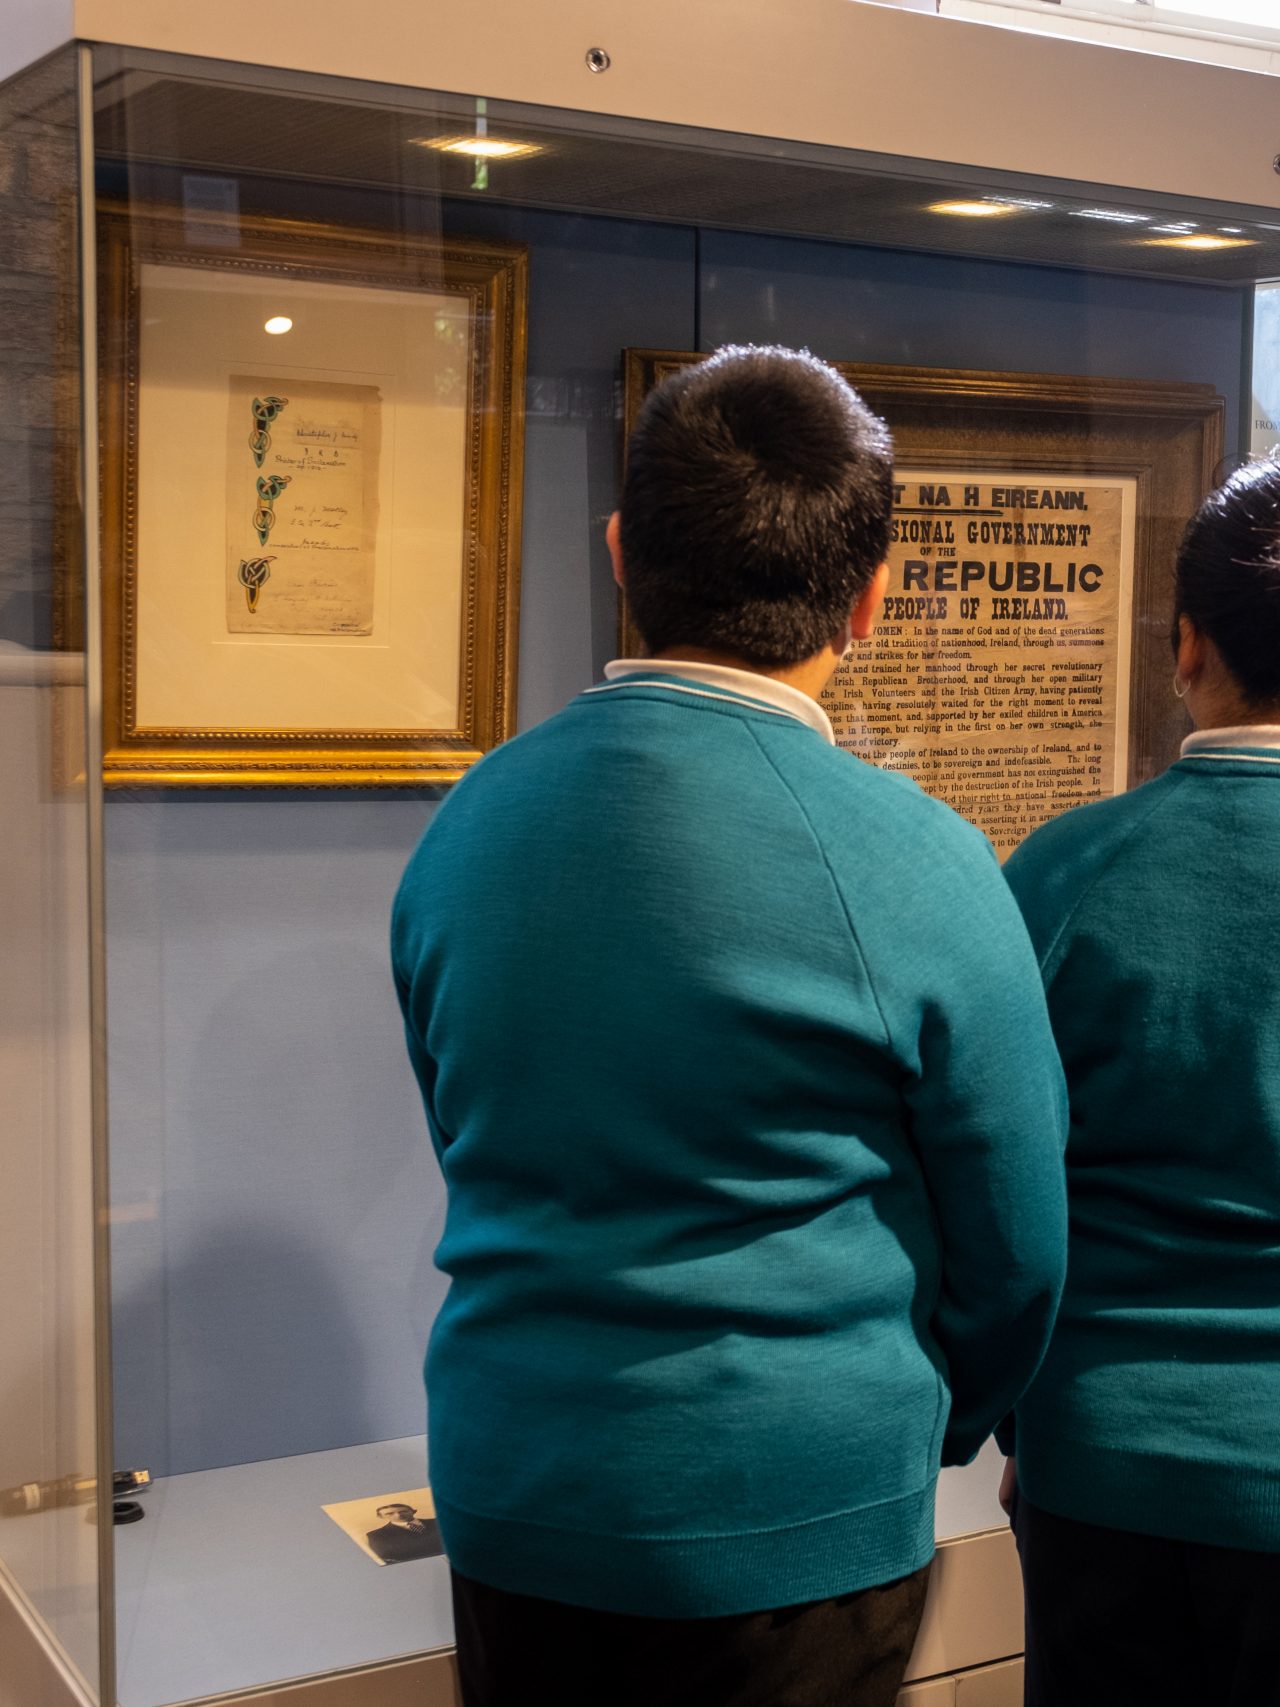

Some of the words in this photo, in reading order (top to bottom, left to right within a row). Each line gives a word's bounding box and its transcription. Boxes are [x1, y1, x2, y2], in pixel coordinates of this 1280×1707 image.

[919, 486, 950, 506] NA
[964, 487, 979, 507] H
[992, 488, 1088, 510] EIREANN.
[968, 521, 1091, 546] GOVERNMENT
[920, 547, 932, 556] OF
[938, 547, 956, 556] THE
[904, 560, 1103, 592] REPUBLIC
[883, 597, 947, 620] PEOPLE
[960, 597, 980, 620] OF
[992, 597, 1068, 620] IRELAND.
[914, 627, 922, 635] In
[926, 627, 938, 635] the
[967, 627, 975, 635] of
[978, 627, 992, 635] God
[995, 627, 1010, 635] and
[1013, 627, 1021, 635] of
[1024, 627, 1036, 635] the
[1039, 627, 1057, 635] dead
[1060, 627, 1104, 636] generations
[859, 640, 871, 648] her
[892, 640, 927, 648] tradition
[932, 639, 939, 647] of
[942, 638, 987, 648] nationhood,
[990, 639, 1020, 647] Ireland,
[1023, 639, 1054, 649] through
[857, 652, 872, 660] and
[876, 651, 903, 659] strikes
[907, 651, 918, 659] for
[922, 651, 934, 659] her
[938, 650, 972, 659] freedom.
[853, 665, 868, 673] and
[872, 664, 901, 672] trained
[906, 664, 919, 672] her
[926, 664, 961, 672] manhood
[967, 664, 998, 673] through
[1052, 663, 1102, 671] revolutionary
[863, 677, 907, 686] Republican
[917, 676, 968, 685] Brotherhood,
[994, 675, 1025, 684] through
[1032, 675, 1044, 683] her
[1050, 676, 1066, 684] open
[1073, 674, 1102, 683] military
[821, 690, 835, 698] the
[872, 689, 915, 697] Volunteers
[922, 688, 936, 696] and
[942, 688, 954, 696] the
[961, 687, 978, 695] Irish
[984, 686, 1010, 695] Citizen
[1014, 686, 1037, 696] Army,
[1040, 686, 1065, 695] having
[1069, 685, 1102, 695] patiently
[863, 701, 891, 710] having
[896, 700, 936, 709] resolutely
[942, 700, 968, 708] waited
[973, 699, 984, 707] for
[991, 698, 1002, 706] the
[1009, 698, 1028, 708] right
[1034, 698, 1064, 706] moment
[1068, 697, 1075, 705] to
[1079, 697, 1102, 705] reveal
[847, 713, 864, 722] that
[927, 712, 966, 722] supported
[969, 710, 979, 720] by
[982, 710, 995, 719] her
[1000, 709, 1023, 718] exiled
[1028, 709, 1058, 718] children
[1062, 709, 1068, 717] in
[1072, 709, 1102, 717] America
[849, 725, 856, 734] in
[862, 724, 892, 735] Europe,
[896, 723, 909, 733] but
[914, 722, 941, 733] relying
[945, 722, 953, 731] in
[958, 721, 971, 731] the
[975, 721, 991, 730] first
[1010, 721, 1022, 729] her
[1051, 720, 1084, 730] strength,
[1089, 719, 1102, 727] she
[859, 738, 866, 746] of
[870, 738, 900, 746] victory.
[874, 750, 886, 758] the
[890, 750, 915, 760] people
[919, 748, 928, 757] of
[930, 748, 957, 757] Ireland
[972, 747, 984, 755] the
[988, 745, 1028, 755] ownership
[1032, 745, 1039, 753] of
[1043, 744, 1072, 752] Ireland,
[1077, 743, 1090, 751] and
[1094, 743, 1101, 751] to
[883, 761, 920, 770] destinies,
[922, 761, 930, 769] to
[934, 760, 941, 768] be
[944, 759, 983, 769] sovereign
[986, 758, 1000, 766] and
[1005, 757, 1052, 766] indefeasible.
[1085, 754, 1101, 764] long
[941, 772, 955, 780] and
[957, 769, 1004, 780] government
[1008, 768, 1021, 777] has
[1038, 767, 1085, 778] extinguished
[1089, 766, 1101, 774] the
[939, 783, 948, 793] by
[952, 782, 963, 791] the
[966, 780, 1009, 791] destruction
[1012, 780, 1020, 788] of
[1022, 779, 1033, 788] the
[1037, 779, 1054, 787] Irish
[1057, 778, 1083, 789] people.
[959, 794, 976, 803] their
[980, 793, 999, 803] right
[1016, 791, 1046, 800] national
[978, 805, 999, 814] years
[1026, 802, 1044, 811] have
[981, 814, 1017, 825] asserting
[1020, 814, 1026, 822] it
[1030, 814, 1036, 822] in
